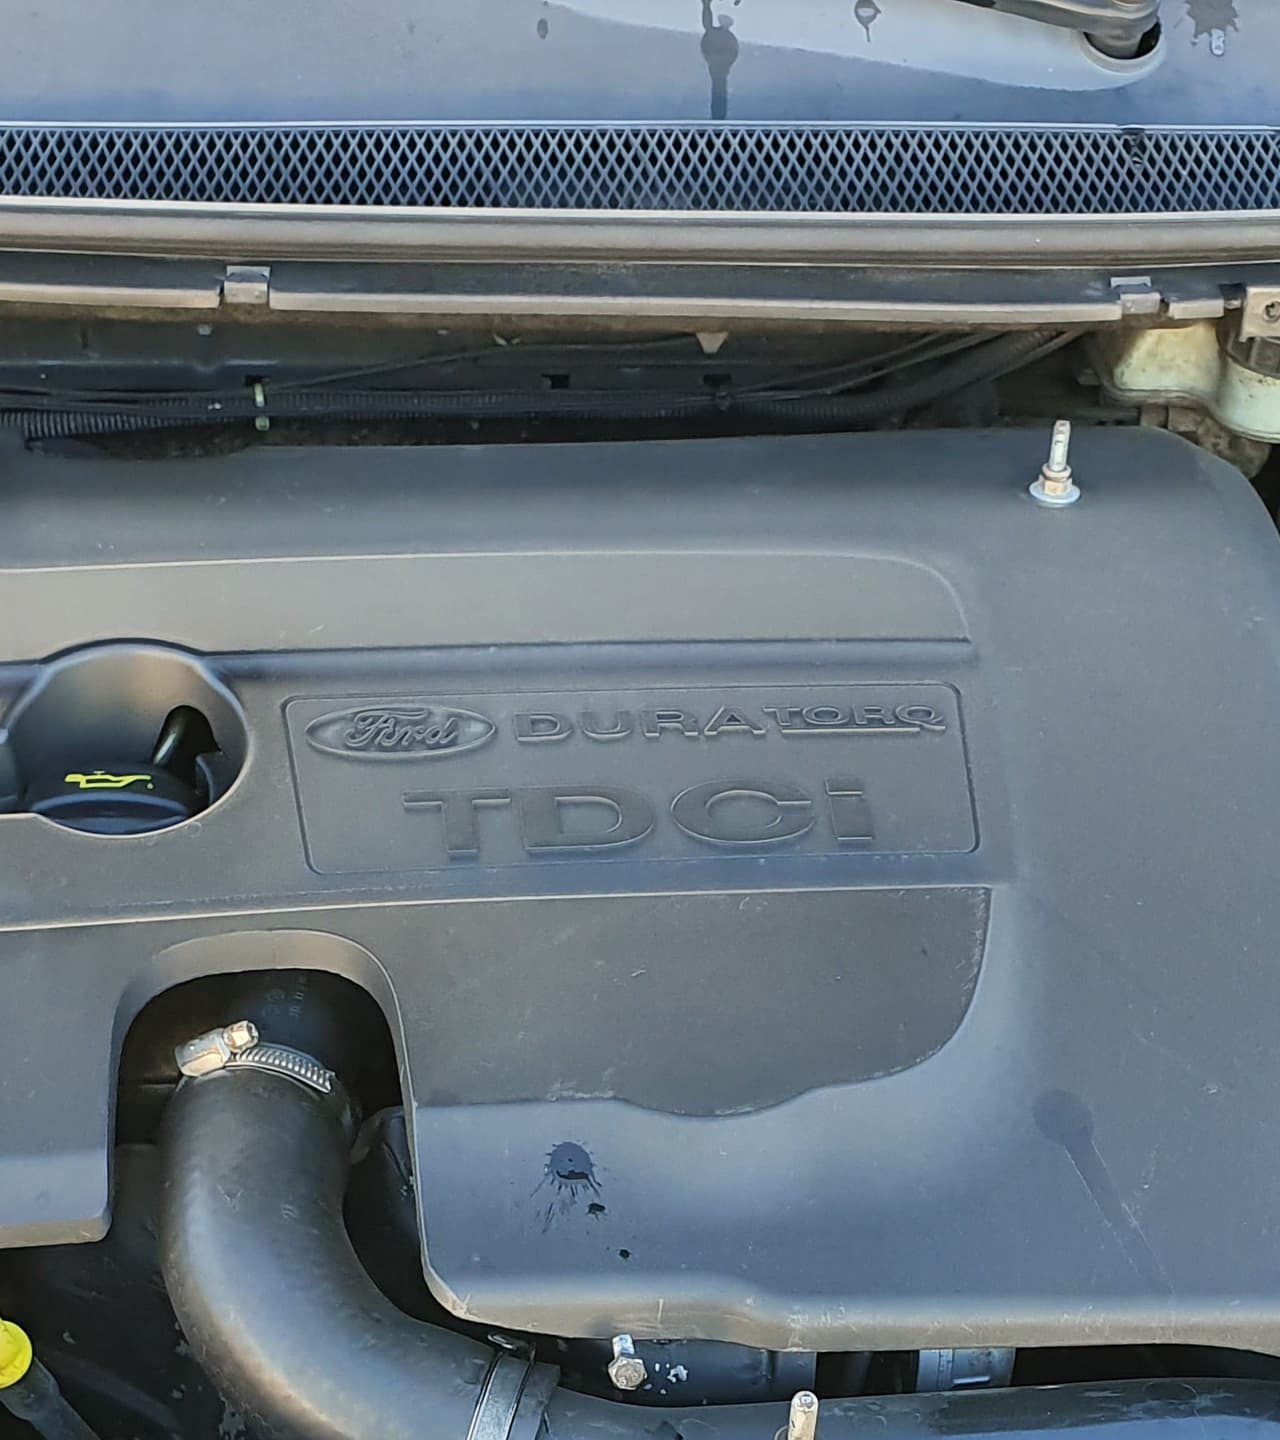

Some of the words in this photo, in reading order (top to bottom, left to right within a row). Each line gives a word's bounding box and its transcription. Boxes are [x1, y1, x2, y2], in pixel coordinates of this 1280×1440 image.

[340, 708, 462, 752] Ford
[515, 705, 947, 744] DURATORQ
[403, 777, 874, 861] TDCi
